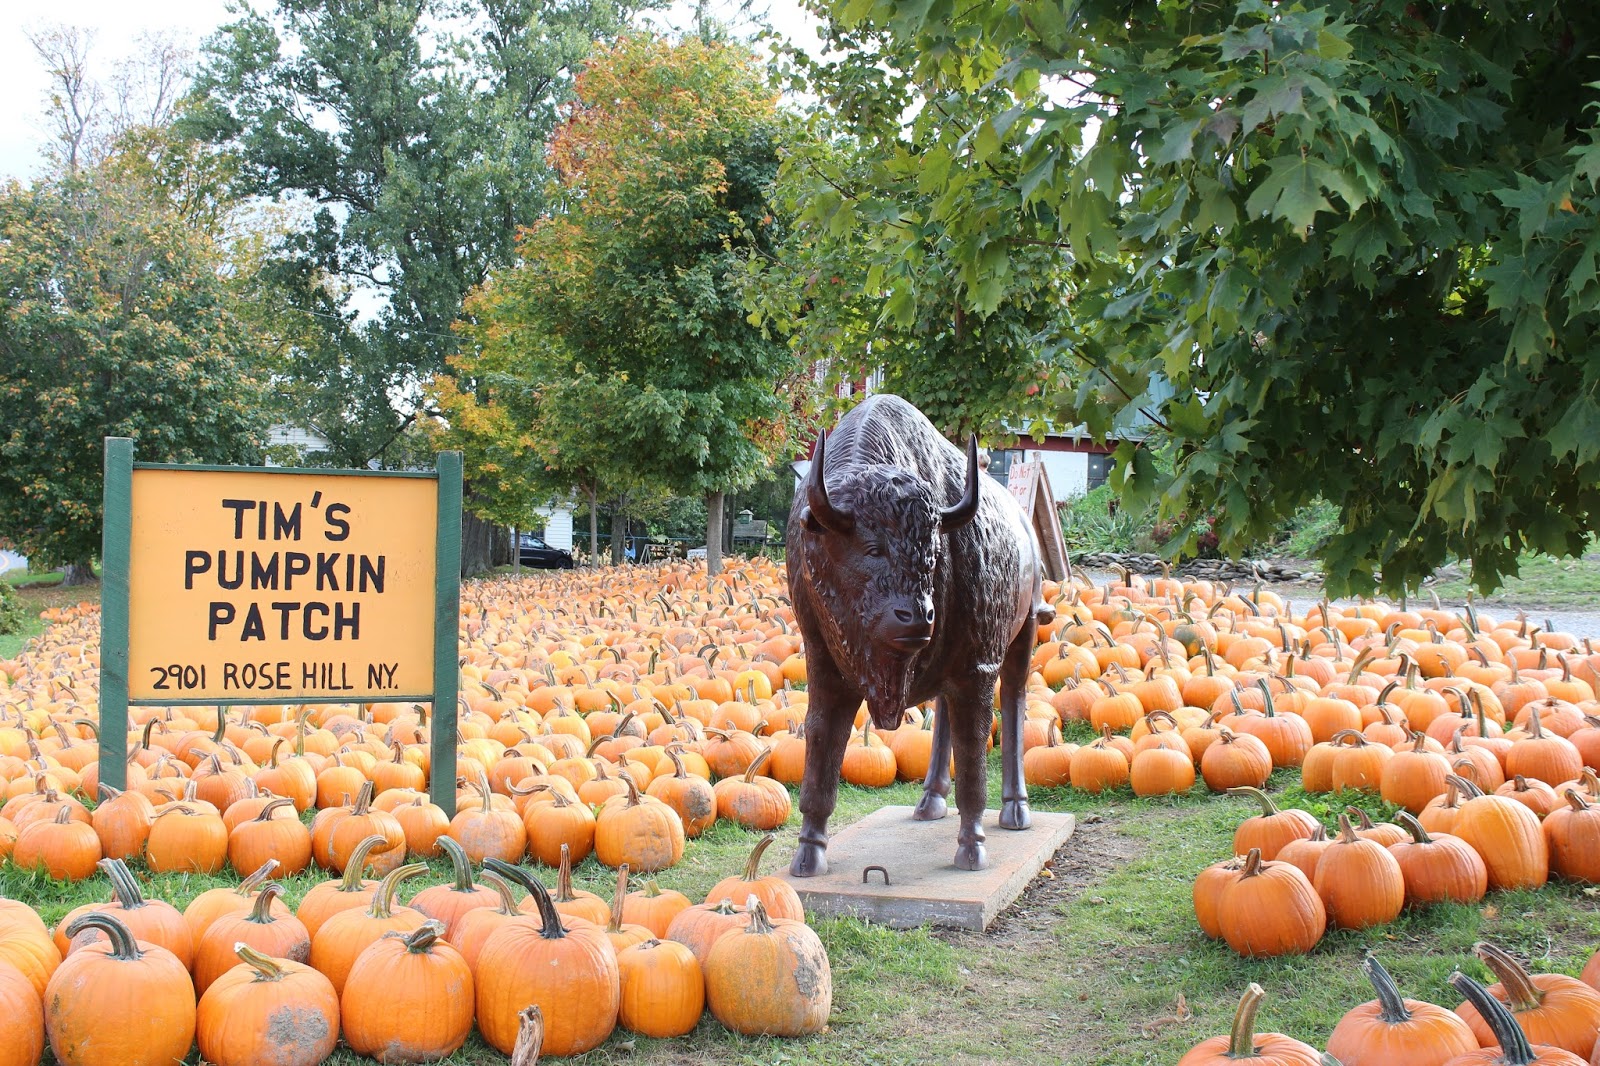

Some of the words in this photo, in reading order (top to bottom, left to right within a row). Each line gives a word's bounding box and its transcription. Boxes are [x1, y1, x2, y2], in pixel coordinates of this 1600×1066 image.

[222, 491, 351, 542] TIM'S
[184, 550, 386, 594] PUMPKIN
[208, 601, 361, 642] PATCH
[150, 663, 206, 690] 2901
[223, 662, 291, 690] ROSE
[302, 662, 354, 691] HILL
